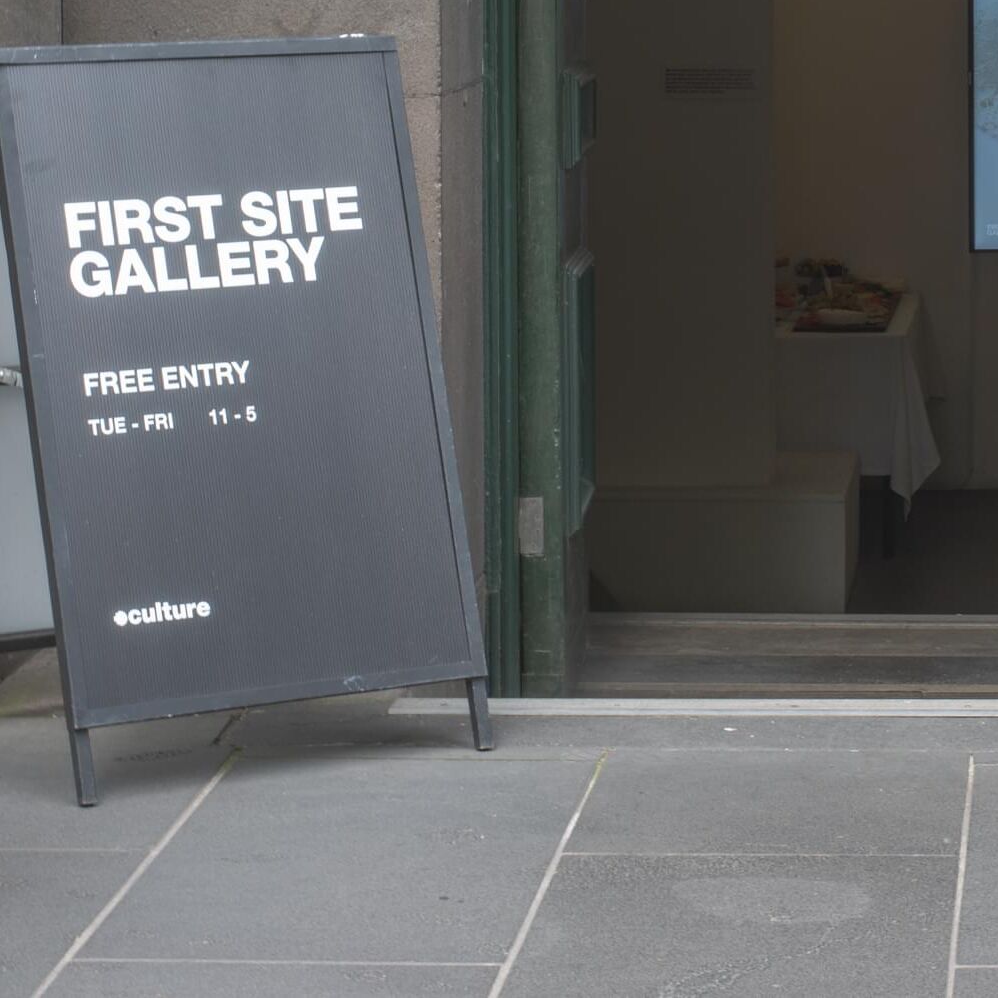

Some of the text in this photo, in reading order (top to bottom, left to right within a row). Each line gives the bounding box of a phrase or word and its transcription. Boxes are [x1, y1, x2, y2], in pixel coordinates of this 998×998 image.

[64, 186, 363, 249] FIRST SITE
[70, 236, 325, 298] GALLERY
[82, 360, 250, 397] FREE ENTRY
[88, 417, 128, 437] TUE
[144, 412, 174, 432] FRI
[208, 407, 228, 426] 11
[245, 405, 257, 423] 5
[128, 601, 211, 625] culture
